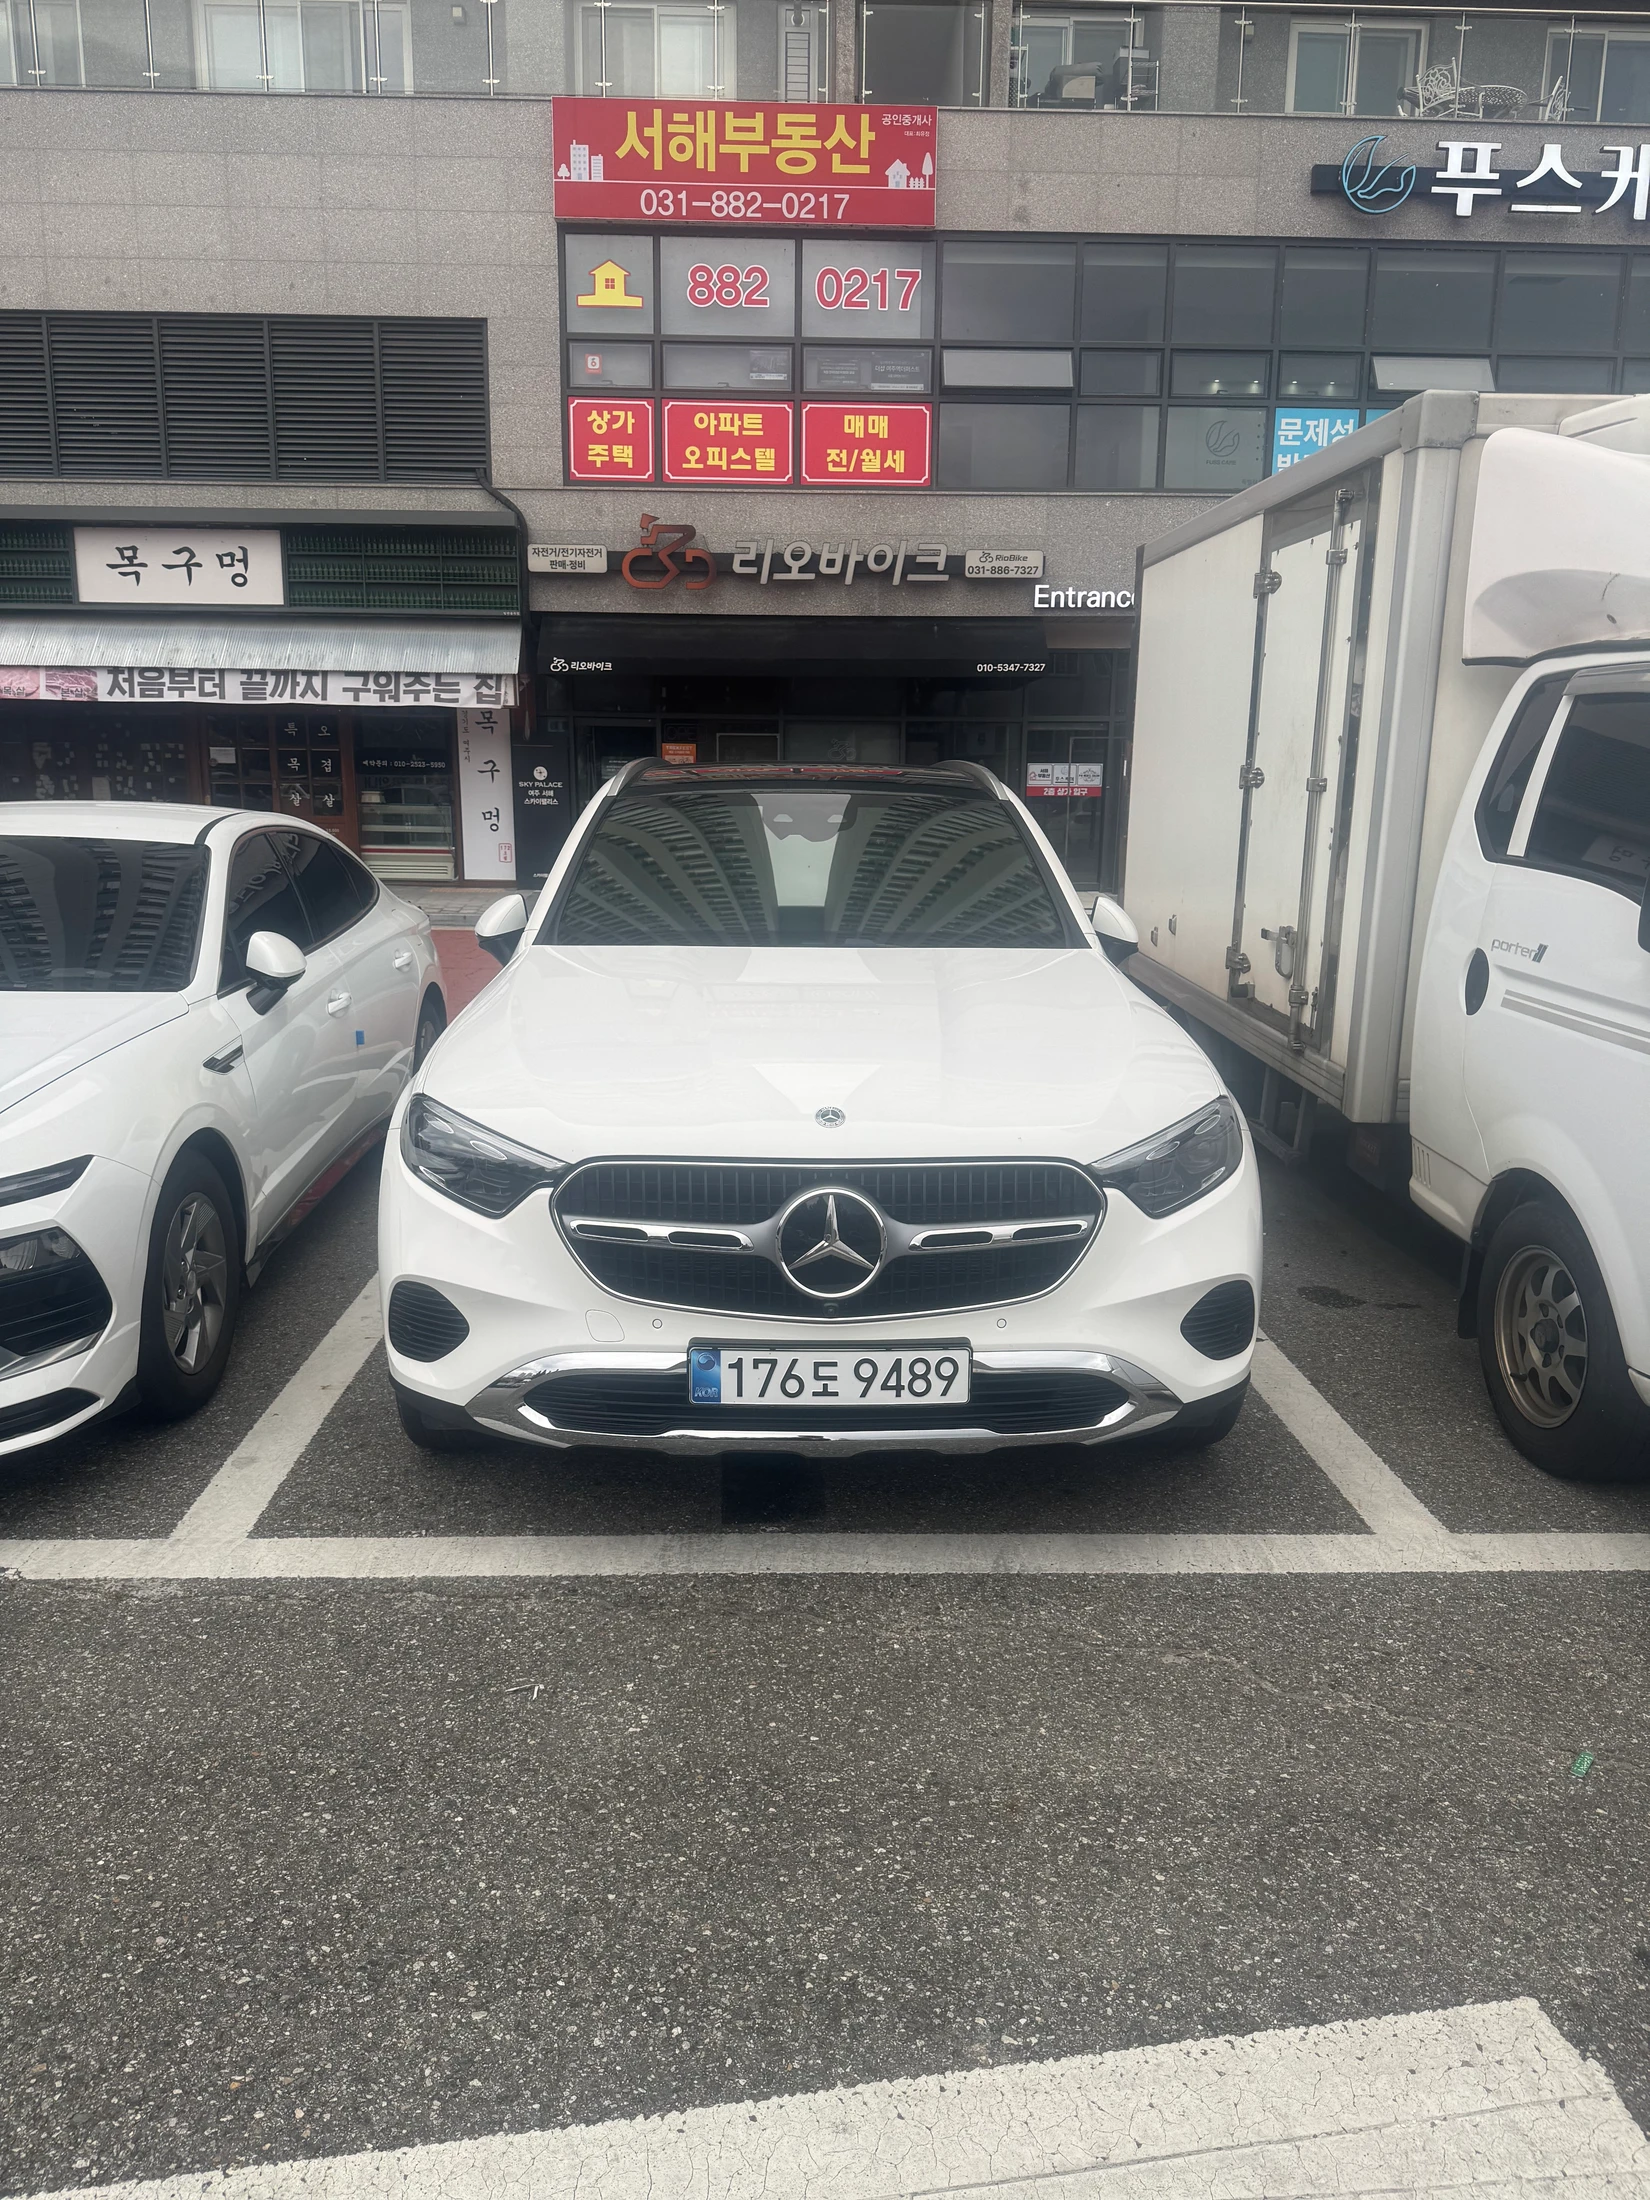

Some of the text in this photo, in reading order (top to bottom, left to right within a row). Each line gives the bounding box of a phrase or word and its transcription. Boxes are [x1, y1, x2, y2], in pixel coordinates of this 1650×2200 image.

[881, 113, 932, 126] 공인중개사
[615, 108, 875, 175] 서해부동산
[640, 189, 850, 219] 031-882-0217
[686, 263, 771, 308] 882
[814, 267, 922, 311] 0217
[587, 410, 635, 435] 상가
[694, 411, 764, 437] 아파트
[843, 414, 890, 439] 매매
[587, 444, 634, 468] 주택
[682, 446, 776, 472] 오피스텔
[826, 448, 906, 474] 전/월세
[532, 547, 602, 558] 자전거/전기자전거
[732, 539, 949, 586] 리오바이크
[995, 554, 1028, 562] RioBike
[106, 545, 250, 587] 목구멍
[967, 565, 1039, 575] 031-886-7327
[1034, 584, 1135, 608] Entranc
[570, 661, 613, 671] 리오바이크
[977, 663, 1045, 672] 010-5347-7327
[107, 667, 226, 700] 처음부터
[240, 668, 327, 702] 끝까지
[342, 670, 461, 703] 구워주는
[473, 673, 502, 705] 집
[475, 710, 500, 832] 목구멍
[528, 789, 540, 797] 여주
[727, 1356, 960, 1398] 176도 9489
[694, 1387, 718, 1398] KOR
